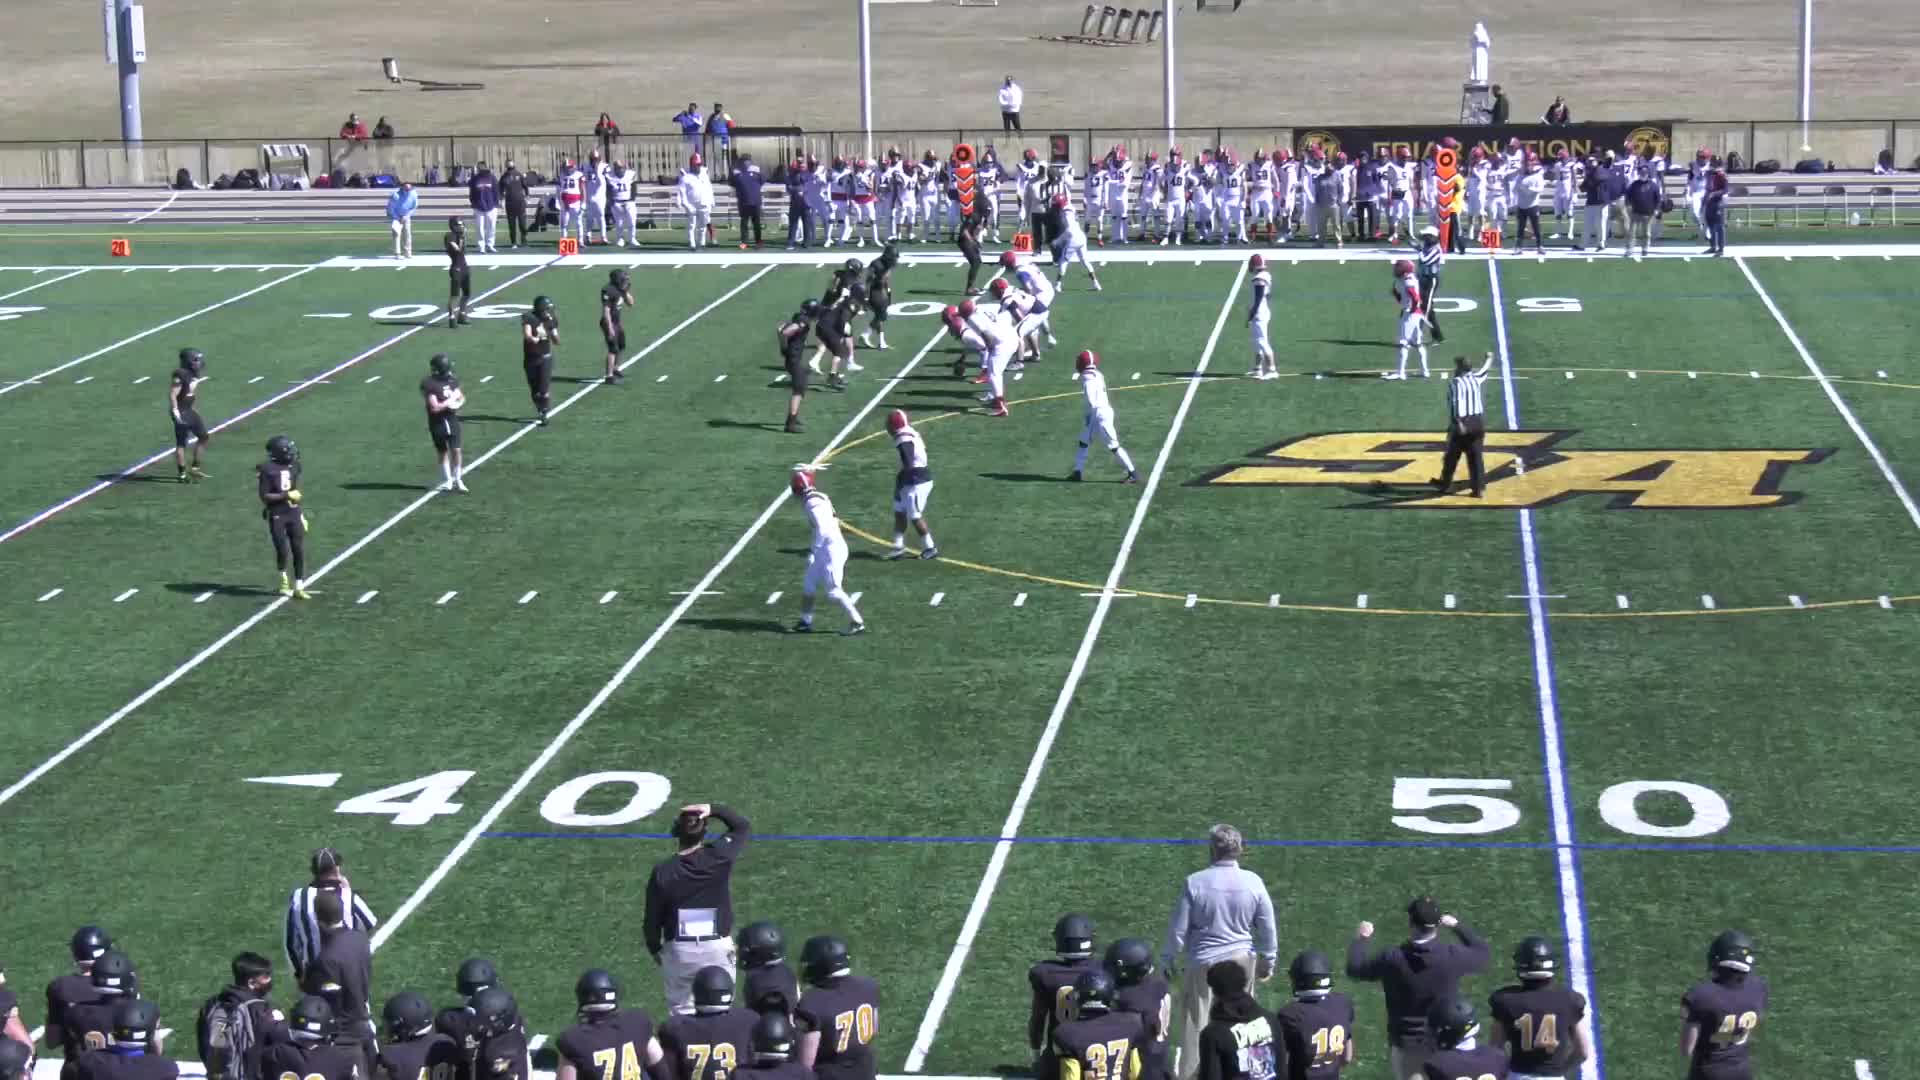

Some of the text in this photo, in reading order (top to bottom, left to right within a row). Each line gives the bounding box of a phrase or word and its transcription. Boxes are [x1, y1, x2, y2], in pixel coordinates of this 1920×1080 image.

[112, 240, 125, 256] 20
[560, 239, 576, 253] 30
[1014, 235, 1029, 250] 40
[1482, 231, 1498, 248] 50
[835, 1003, 873, 1053] 70
[1514, 1013, 1560, 1056] 14
[593, 1041, 641, 1080] 74
[687, 1042, 736, 1080] 73
[1085, 1038, 1129, 1080] 37
